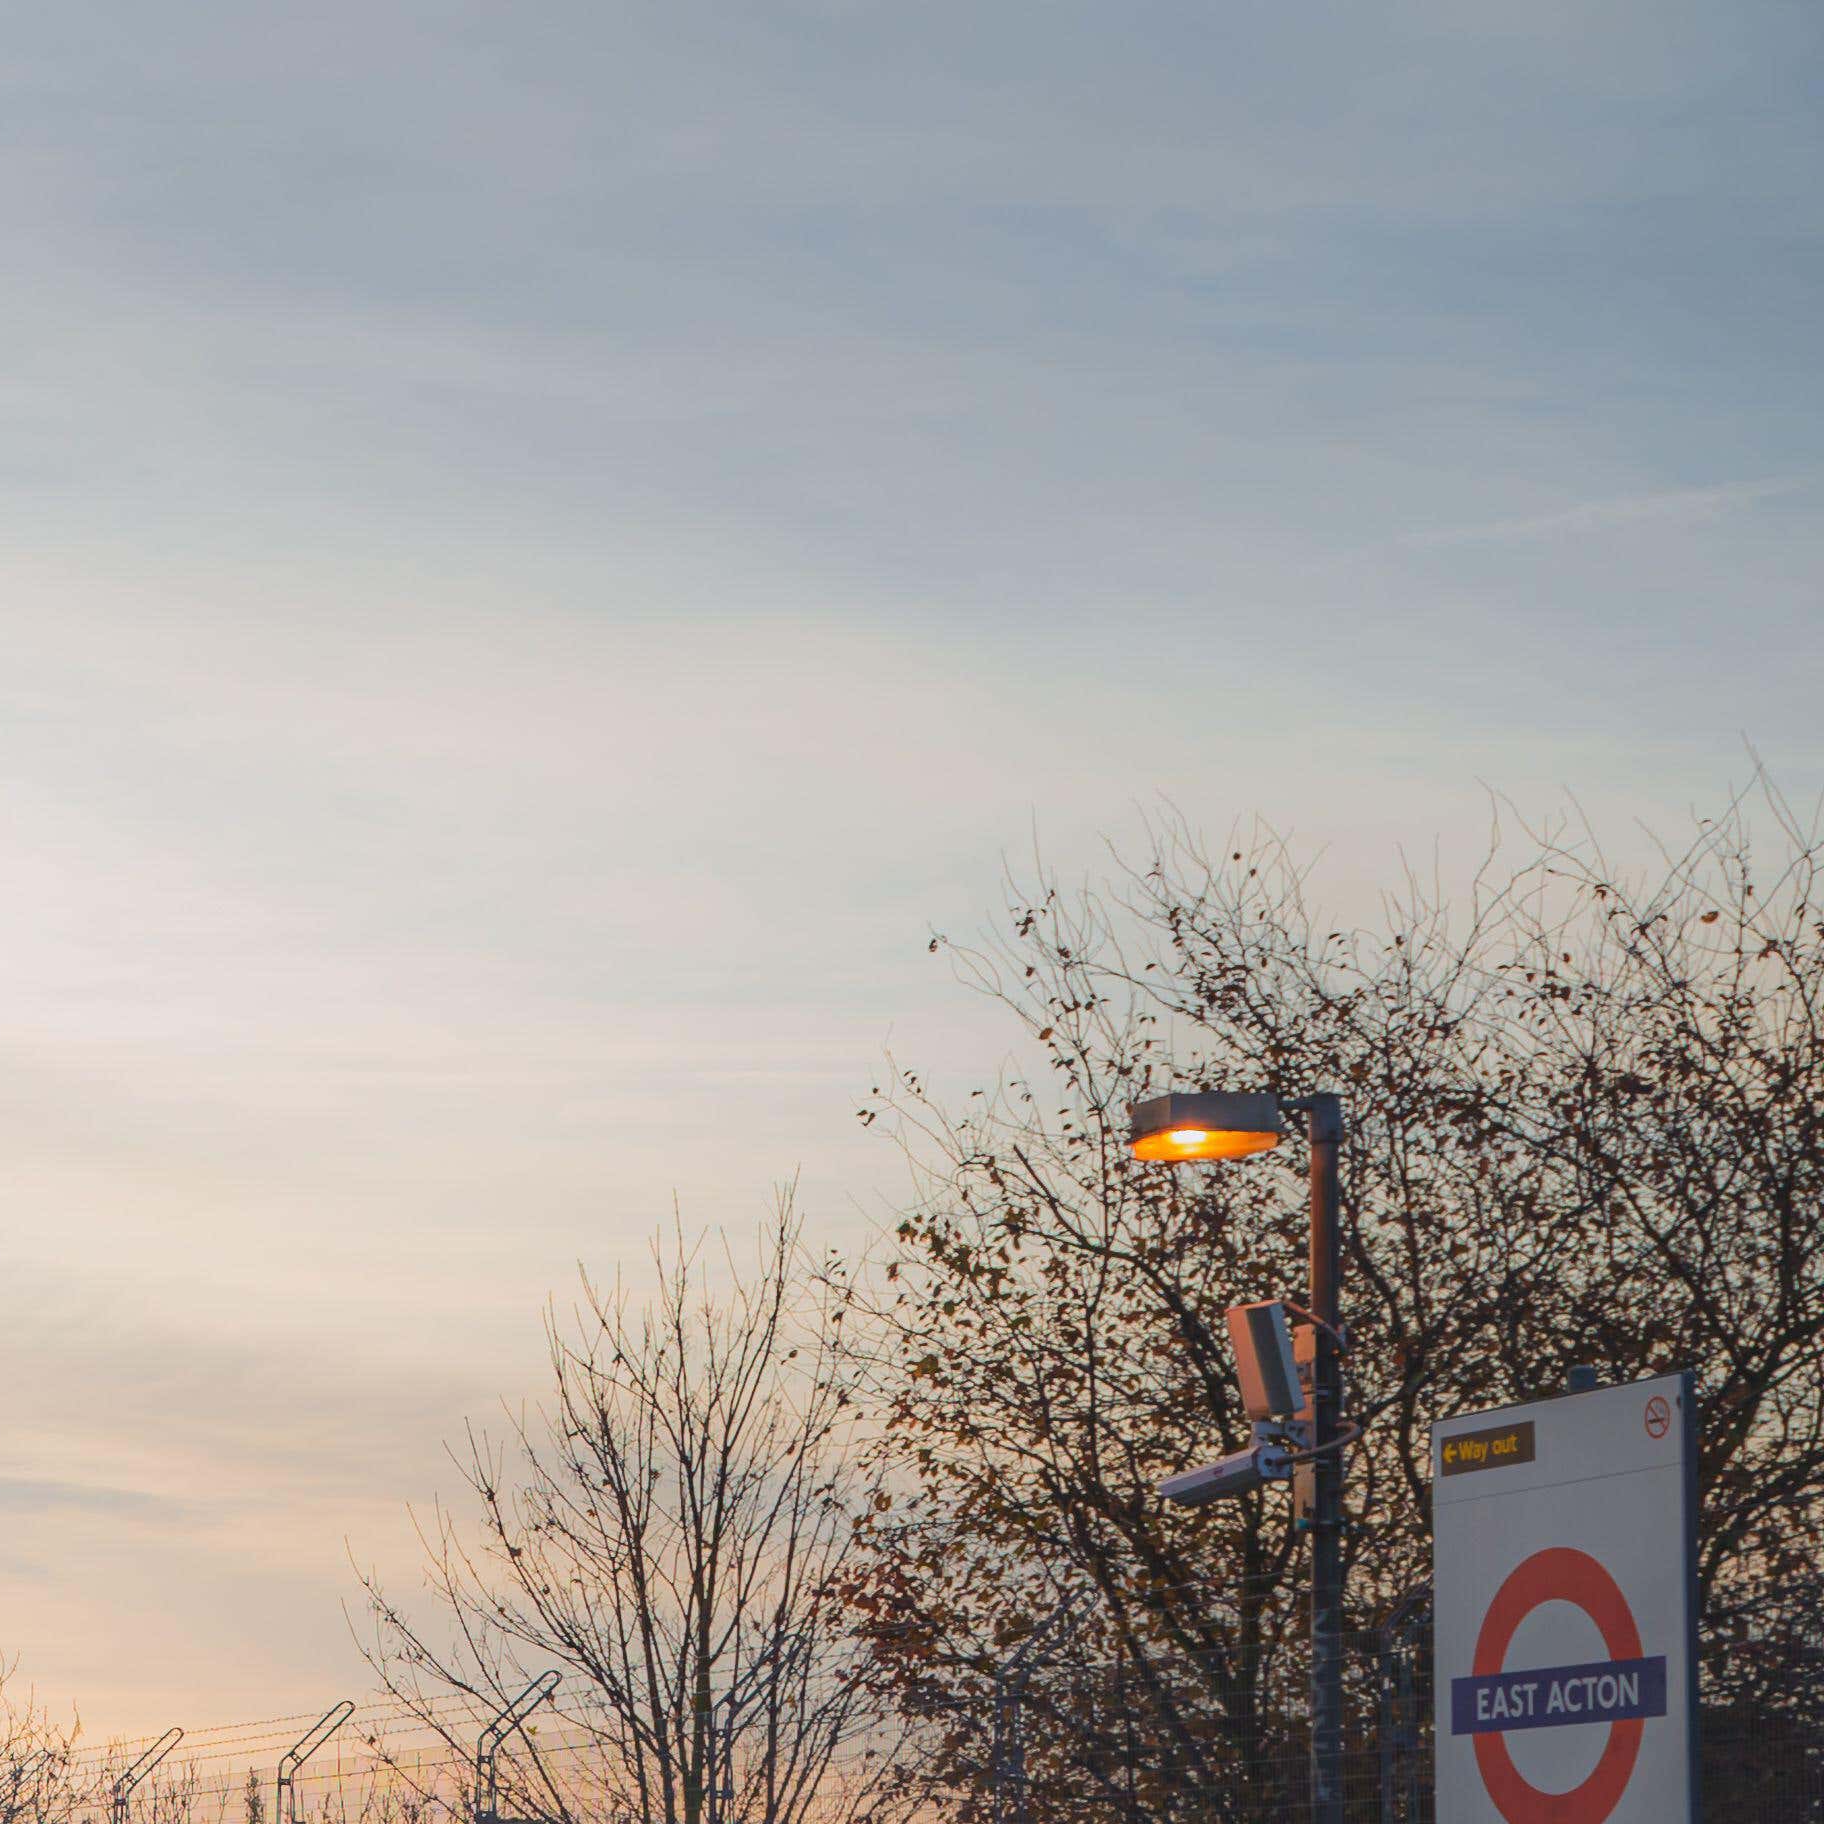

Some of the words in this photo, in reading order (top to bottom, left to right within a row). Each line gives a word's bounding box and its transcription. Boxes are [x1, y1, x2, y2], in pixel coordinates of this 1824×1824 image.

[1458, 1440, 1488, 1463] Way
[1492, 1434, 1518, 1455] out
[1476, 1683, 1537, 1721] EAST
[1546, 1672, 1639, 1714] ACTON
